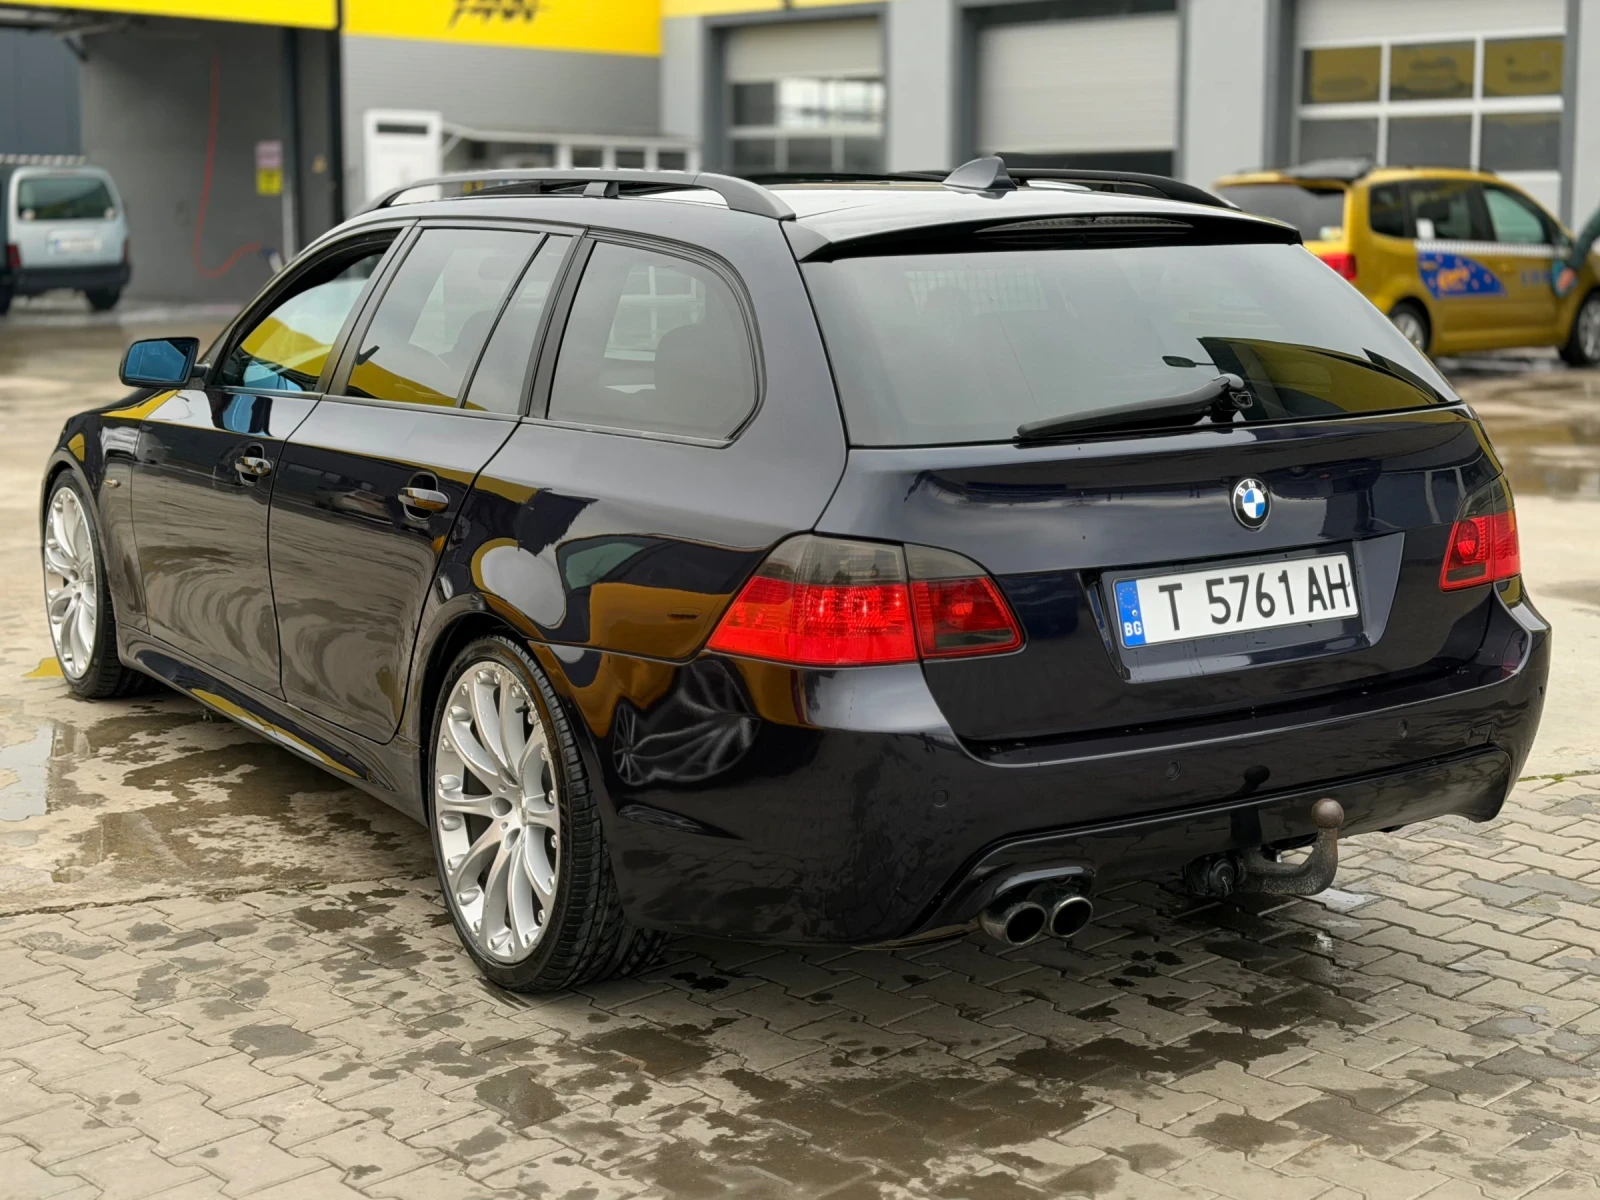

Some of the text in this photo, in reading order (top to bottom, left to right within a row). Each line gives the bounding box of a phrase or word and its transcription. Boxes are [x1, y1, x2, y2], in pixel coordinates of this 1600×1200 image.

[1236, 480, 1267, 497] BMW
[1158, 563, 1351, 631] T 5761 AH
[1123, 621, 1143, 637] BG
